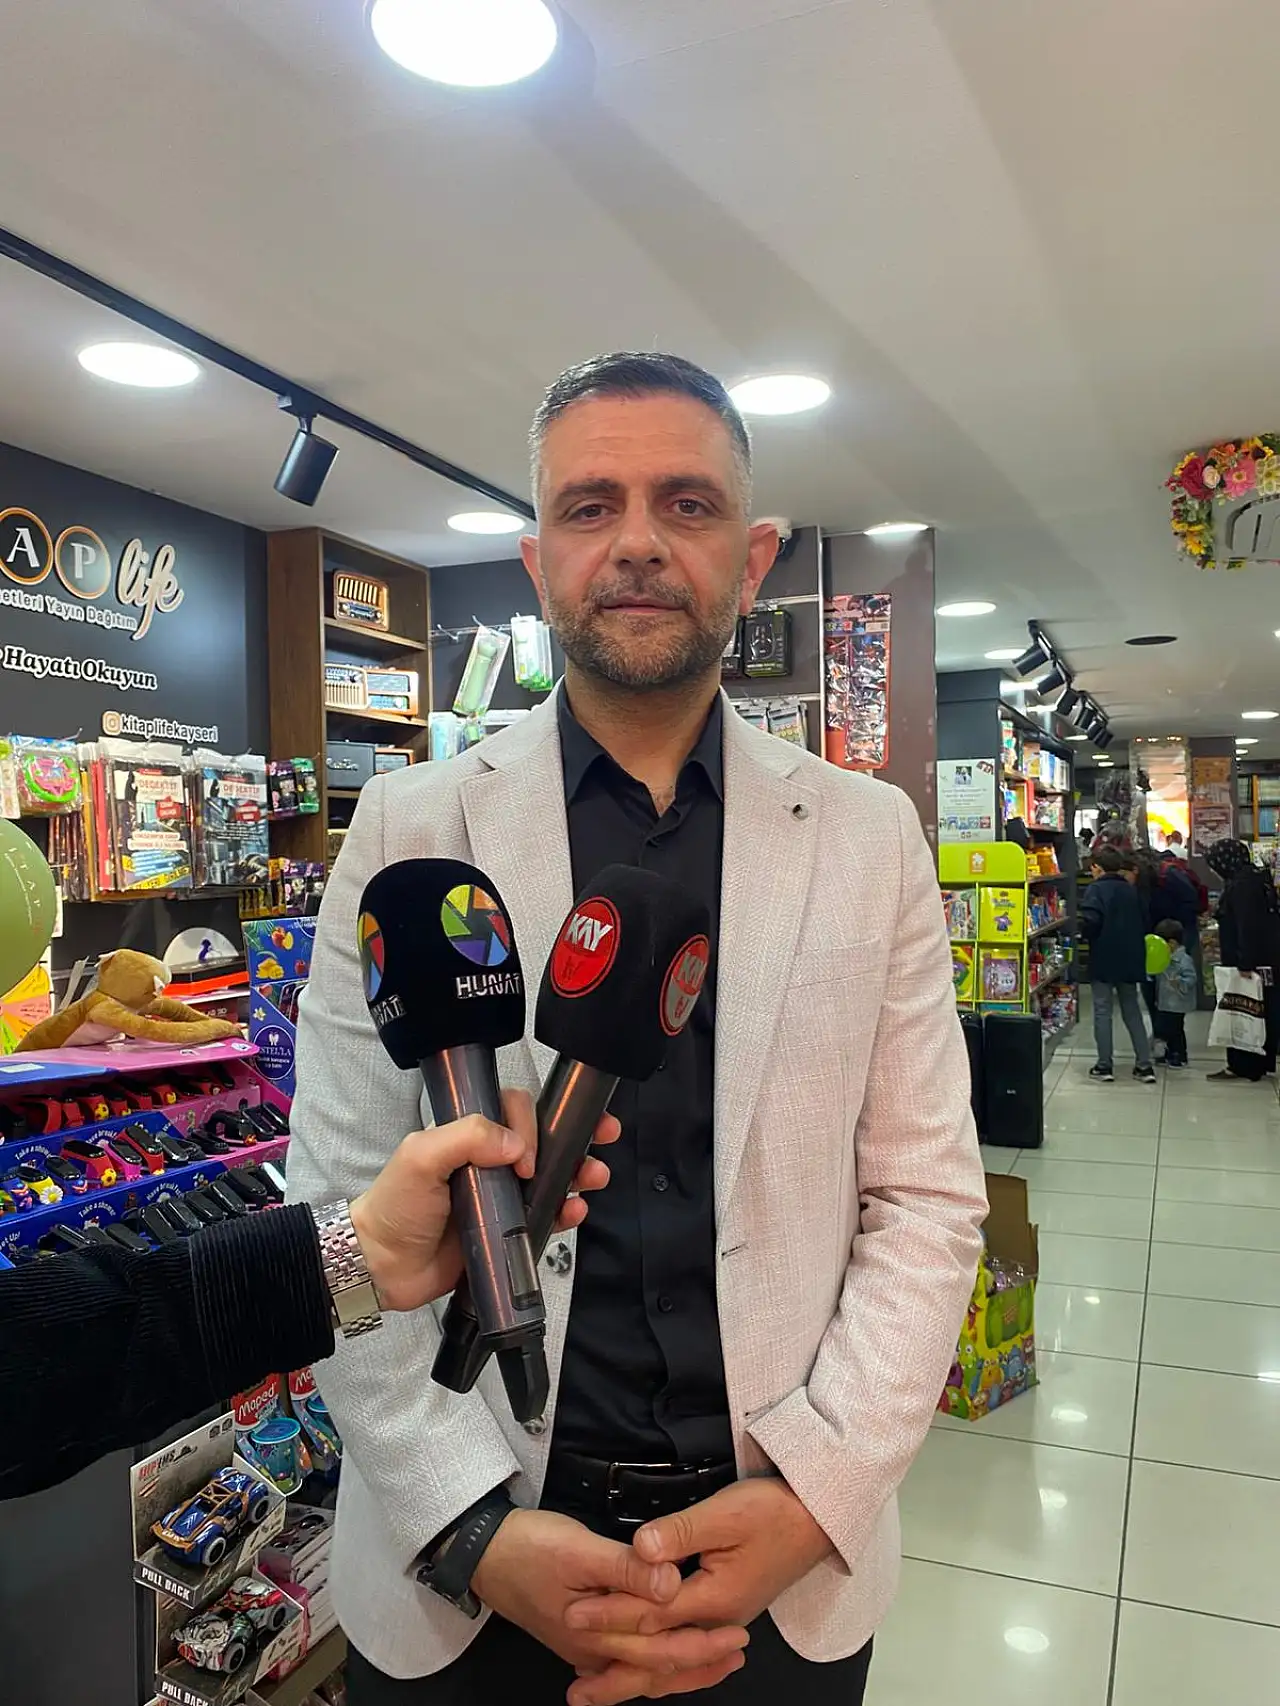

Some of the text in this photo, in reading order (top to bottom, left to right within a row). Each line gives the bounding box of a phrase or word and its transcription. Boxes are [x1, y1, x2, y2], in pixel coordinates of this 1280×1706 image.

[0, 588, 138, 629] etleri Yayın Dağıtım
[118, 538, 184, 641] life
[4, 645, 157, 690] Hayatı Okuyun
[120, 714, 219, 744] kitaplifekayseri
[455, 972, 521, 999] HUNAT
[238, 1381, 277, 1422] Maped
[141, 1566, 191, 1601] PULL BACK
[161, 1680, 211, 1706] PULL BACK
